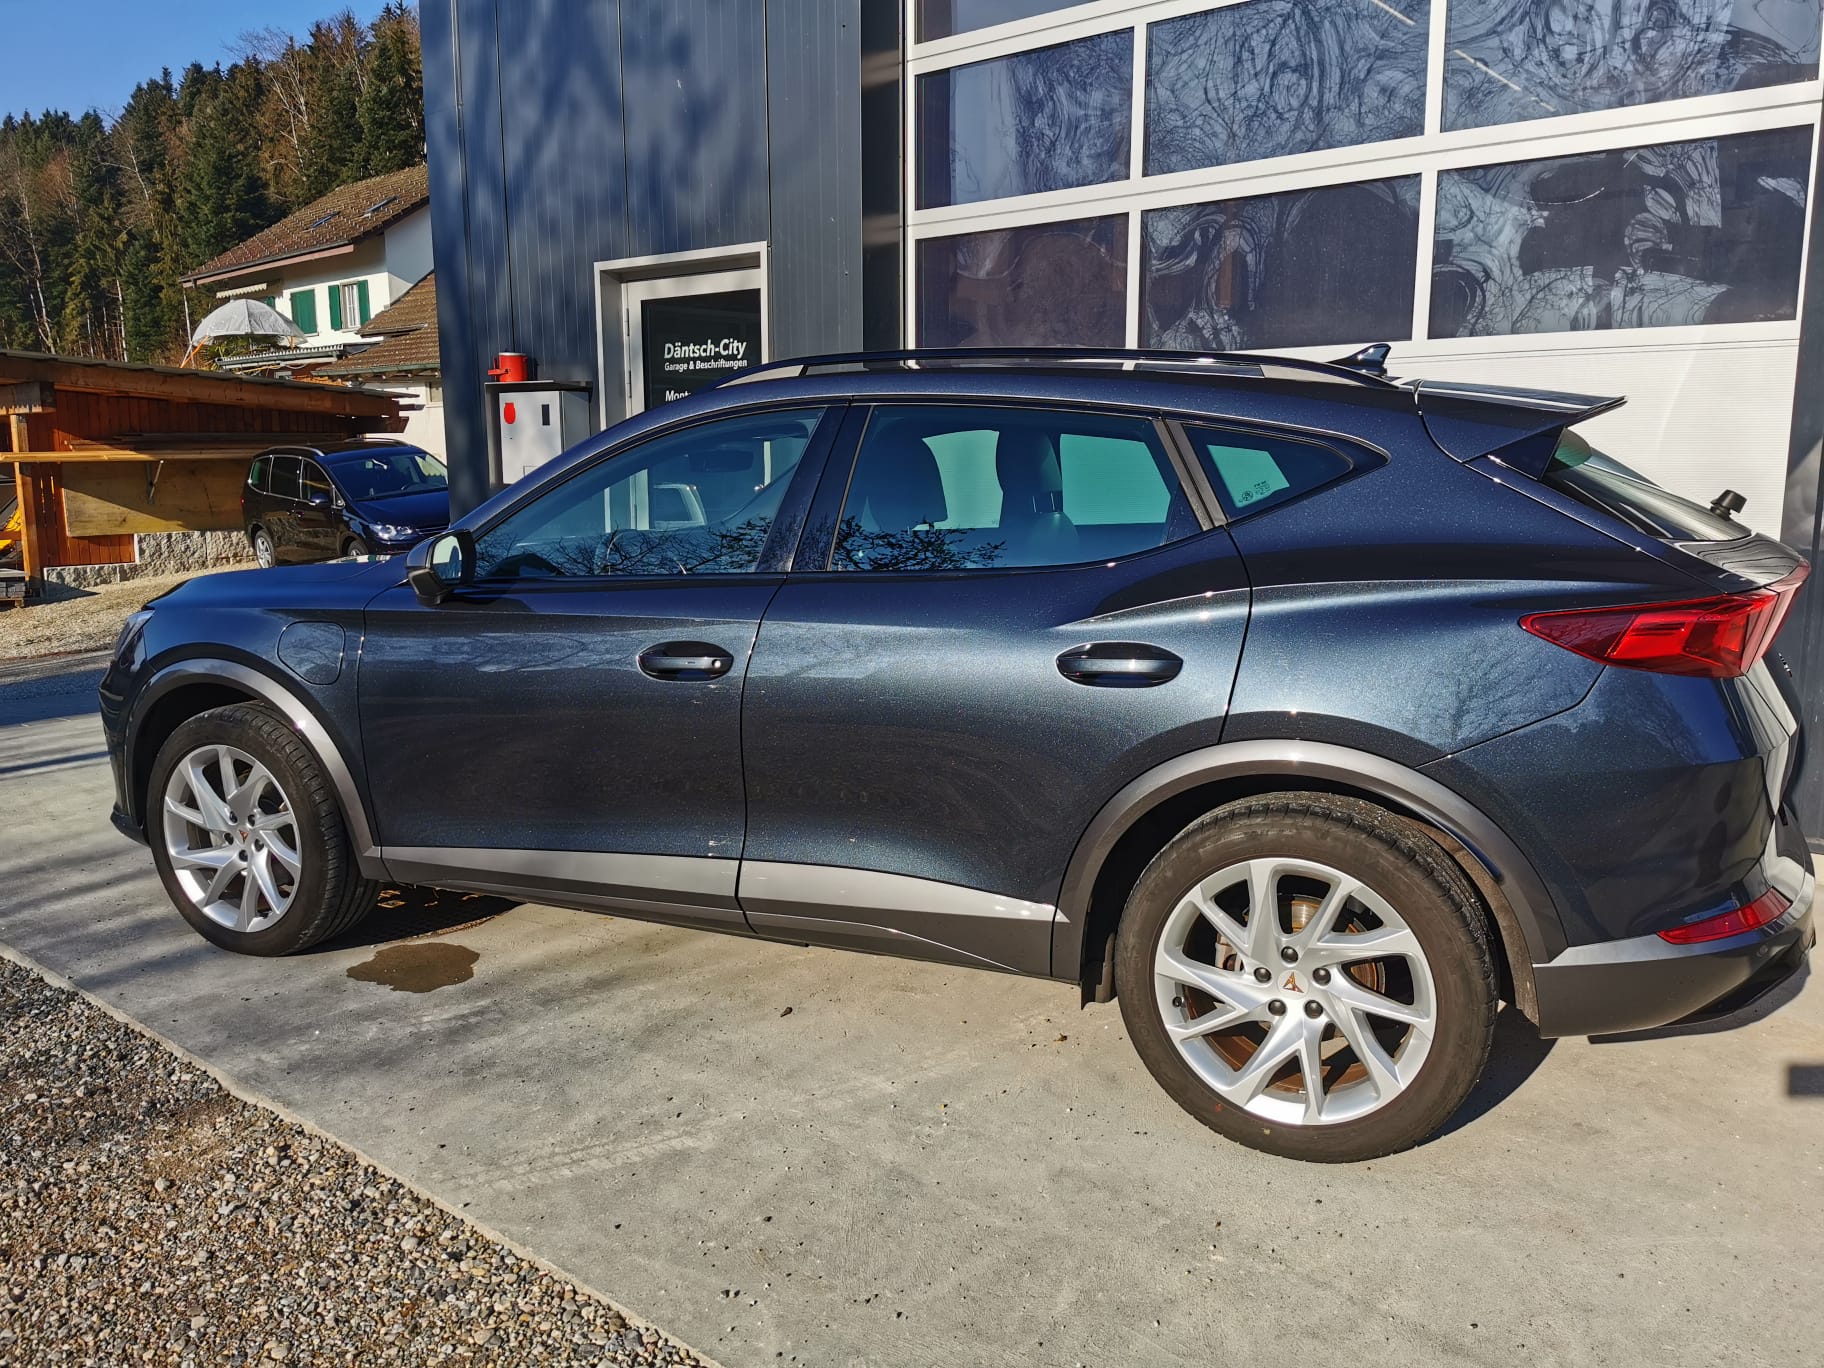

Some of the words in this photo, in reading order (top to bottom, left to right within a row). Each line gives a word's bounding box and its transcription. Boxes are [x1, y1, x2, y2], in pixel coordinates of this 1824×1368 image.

[664, 338, 747, 359] Däntsch-City
[664, 362, 688, 373] Garage
[689, 361, 695, 370] &
[696, 358, 748, 370] Beschriftungen
